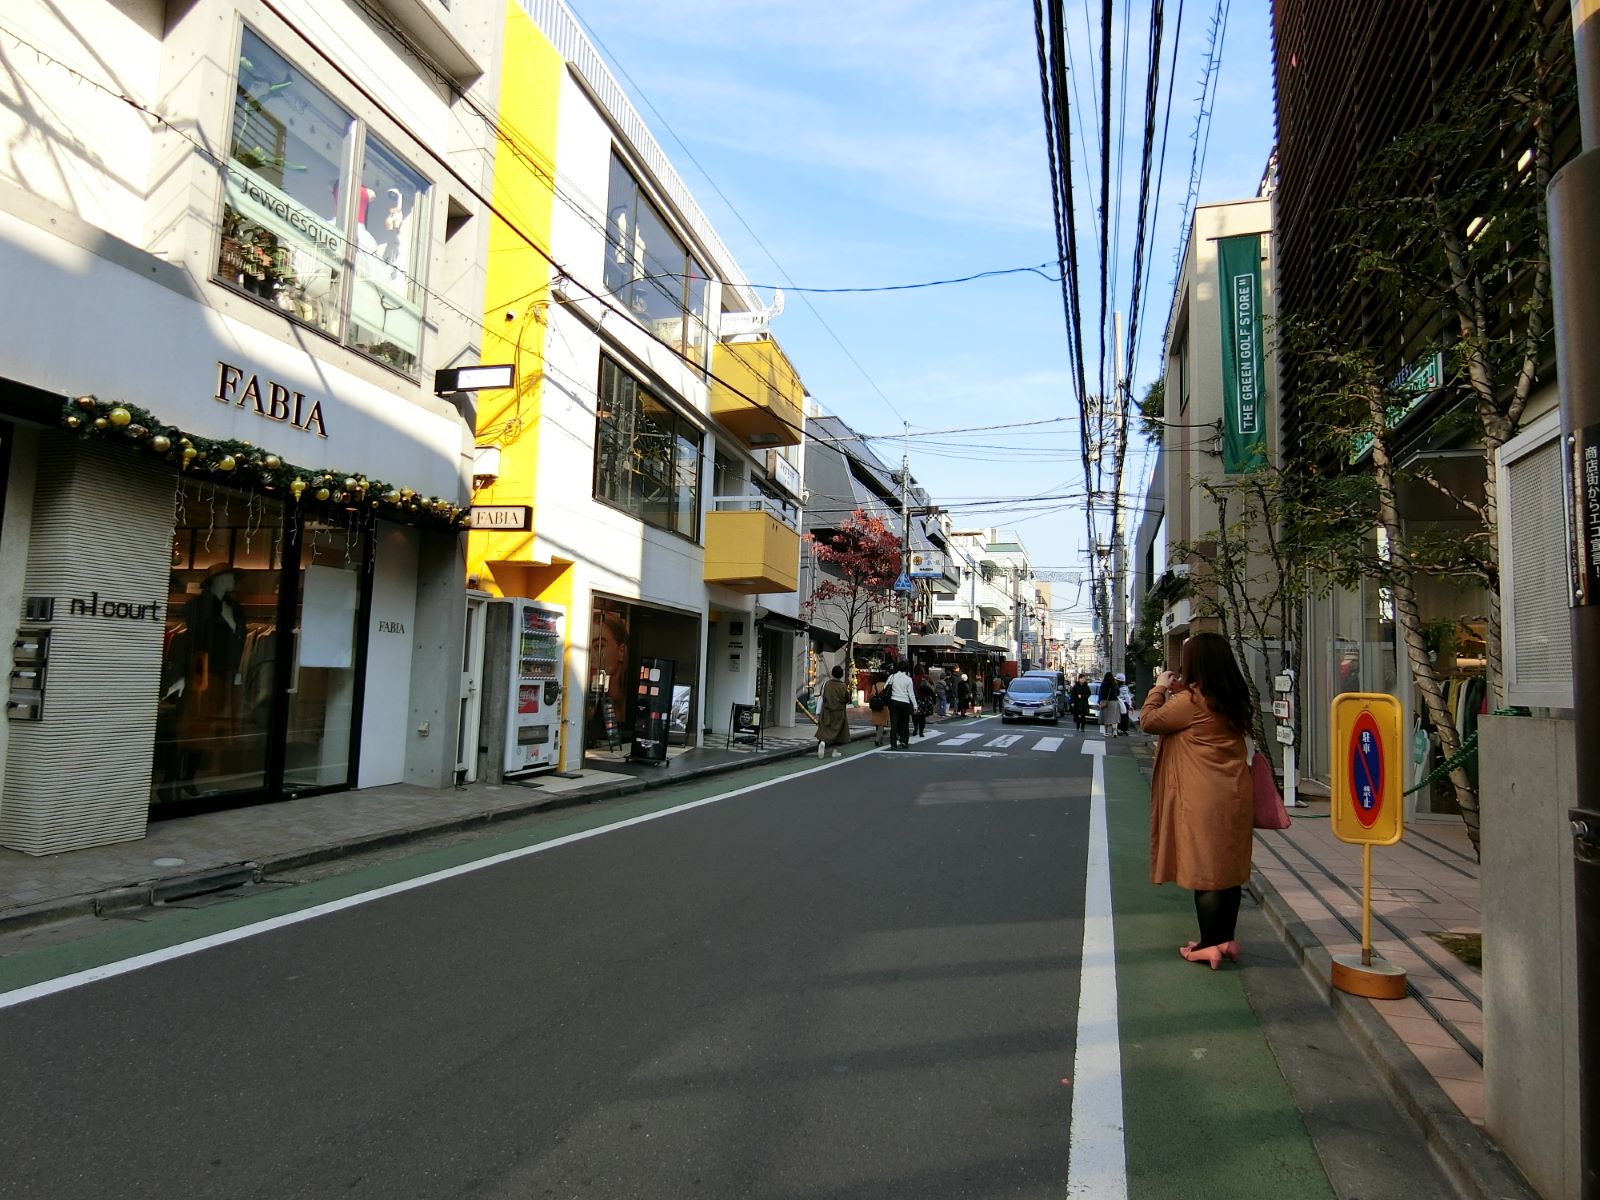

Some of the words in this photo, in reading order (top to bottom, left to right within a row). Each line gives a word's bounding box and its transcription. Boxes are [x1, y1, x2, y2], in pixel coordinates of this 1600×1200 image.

[241, 177, 338, 252] Jewelesque
[1239, 286, 1250, 325] STORE
[1240, 328, 1251, 359] GOLF
[1241, 362, 1253, 400] GREEN
[214, 361, 329, 438] FABIA
[1243, 404, 1254, 428] THE
[476, 511, 519, 525] FABIA
[103, 600, 162, 622] court
[379, 620, 405, 634] FABIA
[1362, 731, 1371, 755] 駐車
[1363, 785, 1372, 809] 禁止
